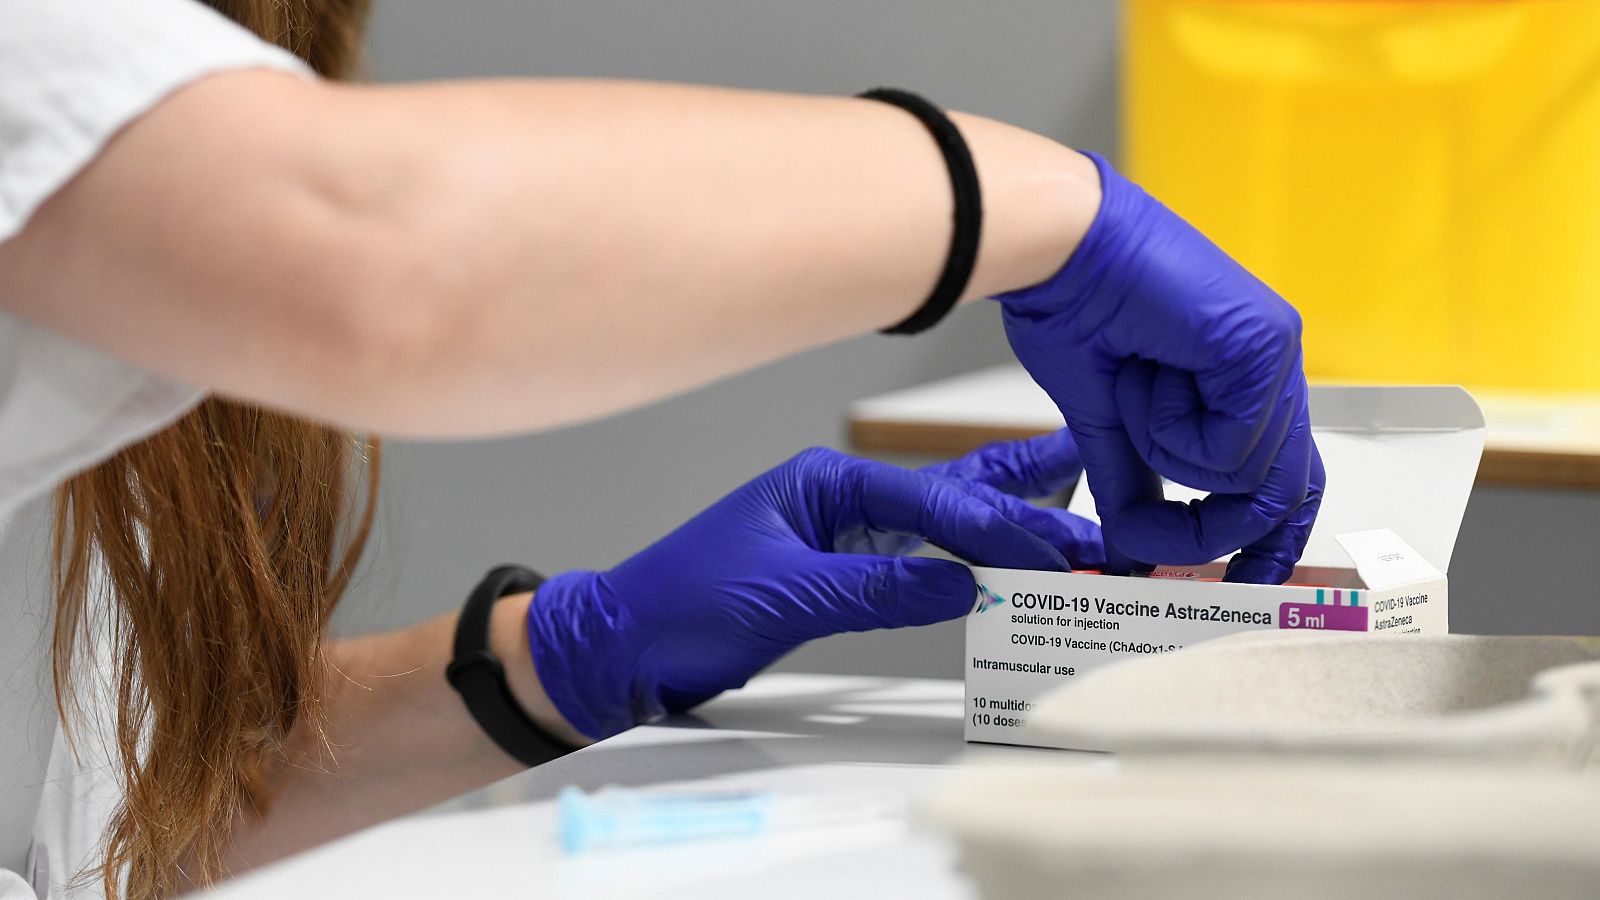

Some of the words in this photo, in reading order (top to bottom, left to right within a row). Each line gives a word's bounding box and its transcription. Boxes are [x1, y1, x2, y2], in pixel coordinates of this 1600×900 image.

[1011, 592, 1090, 613] COVID-19
[1094, 597, 1160, 618] Vaccine
[1164, 602, 1272, 625] AstraZeneca
[1374, 596, 1404, 613] COVID-19
[1404, 593, 1429, 607] Vaccine
[1011, 613, 1053, 626] solution
[1056, 615, 1072, 627] for
[1074, 617, 1120, 630] injection
[1287, 607, 1301, 627] 5
[1305, 613, 1325, 628] ml
[1374, 615, 1413, 630] AstraZeneca
[1011, 633, 1062, 648] COVID-19
[1064, 637, 1107, 651] Vaccine
[973, 657, 1052, 674] Intramuscular
[1054, 665, 1075, 676] use
[972, 697, 986, 709] 10
[972, 713, 990, 727] (10
